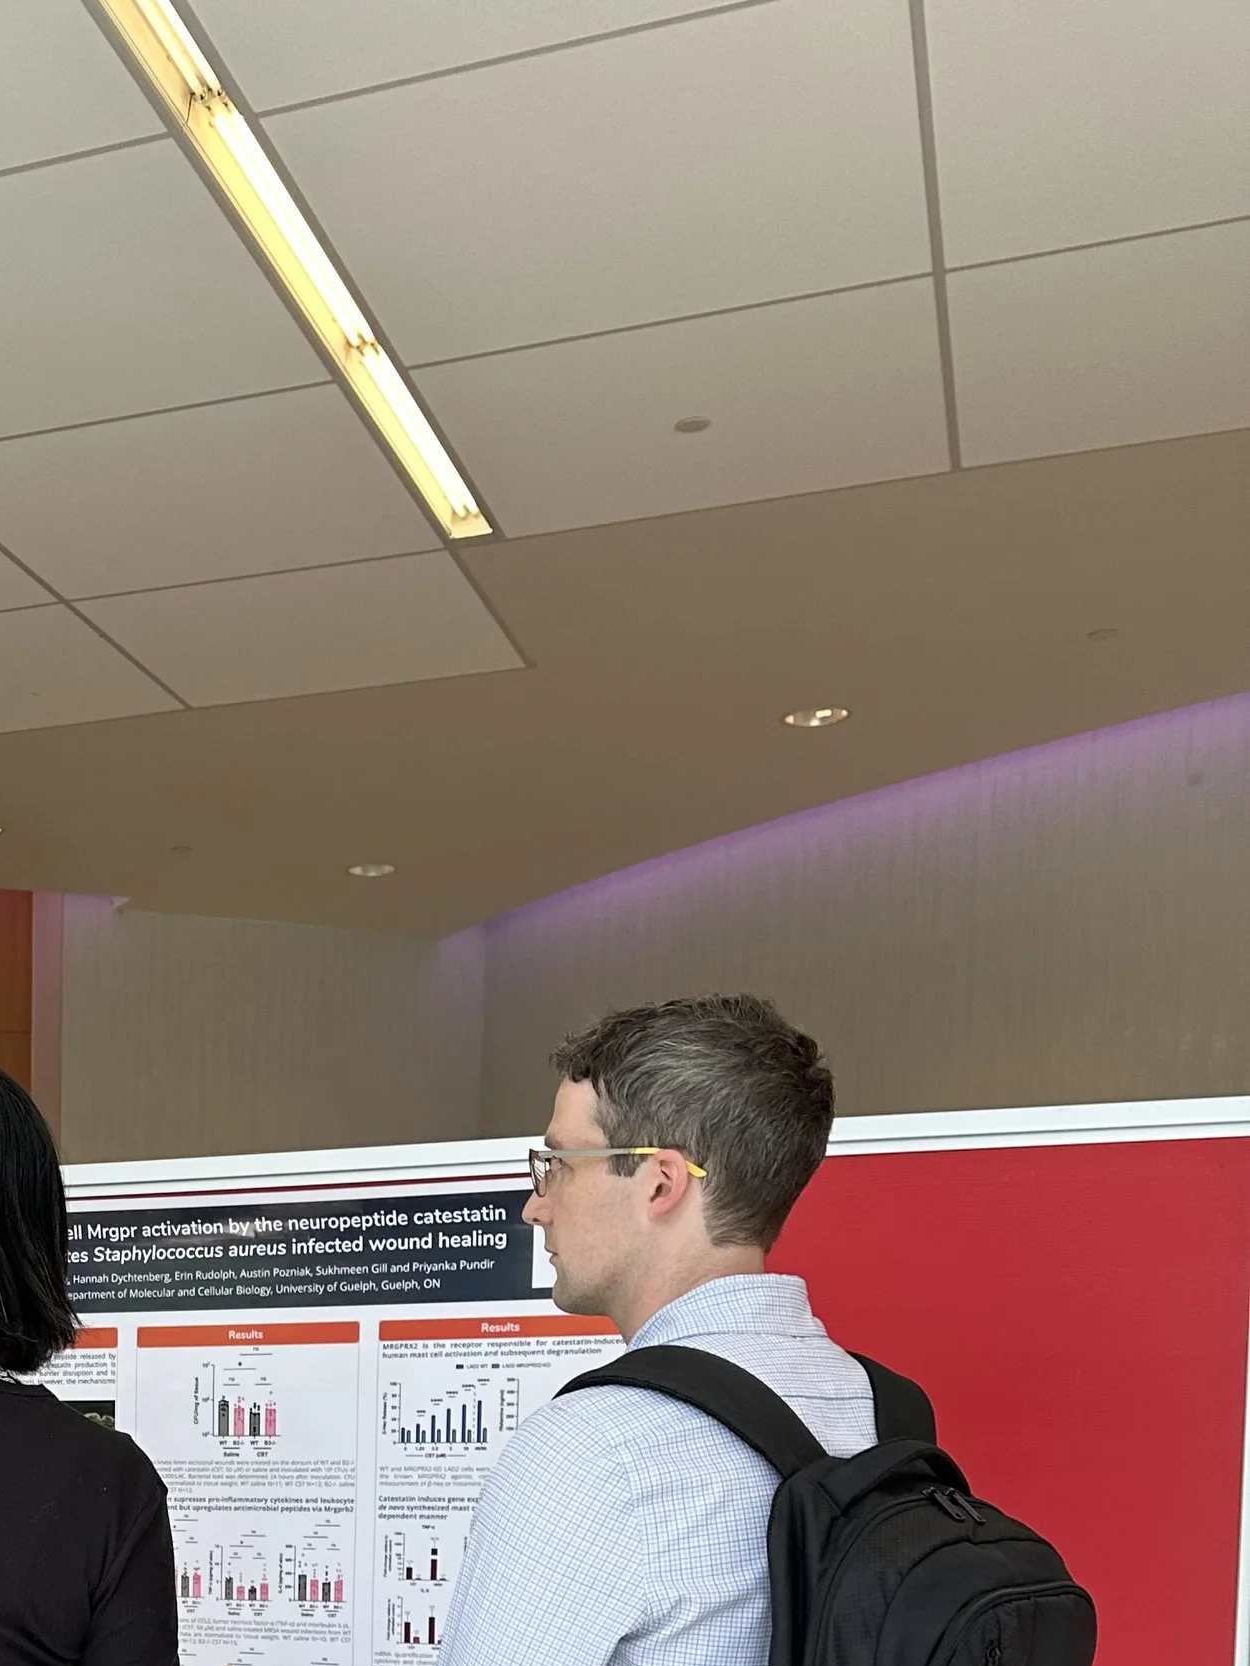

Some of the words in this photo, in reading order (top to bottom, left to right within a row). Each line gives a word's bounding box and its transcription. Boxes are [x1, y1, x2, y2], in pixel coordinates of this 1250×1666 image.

[67, 1224, 82, 1240] ell
[87, 1224, 138, 1243] Mrgpr
[141, 1219, 224, 1237] activation
[228, 1217, 250, 1238] by
[255, 1216, 283, 1233] the
[288, 1210, 409, 1232] neuropeptide
[413, 1204, 507, 1225] catestatin
[93, 1245, 224, 1264] Staphylococcus
[228, 1241, 287, 1258] aureus
[291, 1236, 364, 1255] infected
[369, 1232, 433, 1251] wound
[438, 1229, 508, 1250] healing
[73, 1274, 109, 1285] Hannah
[111, 1271, 172, 1286] Dychtenberg,
[174, 1270, 194, 1281] Erin
[195, 1268, 238, 1281] Rudolph,
[239, 1268, 271, 1279] Austin
[315, 1264, 369, 1276] Sukhmeen
[371, 1263, 388, 1273] Gill
[390, 1262, 410, 1273] and
[412, 1260, 457, 1273] Priyanka
[459, 1258, 496, 1270] Pundir
[68, 1289, 115, 1301] epartment
[117, 1288, 129, 1299] of
[129, 1287, 175, 1299] Molecular
[177, 1286, 196, 1297] and
[197, 1285, 234, 1296] Cellular
[236, 1284, 274, 1297] Biology,
[275, 1281, 325, 1296] University
[327, 1280, 338, 1292] of
[339, 1280, 378, 1293] Guelph,
[381, 1279, 421, 1292] Guelph,
[423, 1278, 441, 1289] ON
[481, 1322, 521, 1333] Results
[228, 1330, 264, 1341] Results
[422, 1342, 429, 1350] is
[433, 1342, 446, 1350] the
[450, 1342, 483, 1350] receptor
[487, 1340, 532, 1349] responsible
[536, 1339, 548, 1347] for
[430, 1350, 443, 1358] cell
[444, 1350, 483, 1358] activation
[500, 1348, 545, 1357] subsequent
[546, 1347, 602, 1357] degranulation
[305, 1496, 319, 1504] and
[417, 1495, 446, 1503] induces
[447, 1496, 466, 1504] gene
[178, 1503, 191, 1511] but
[192, 1504, 232, 1512] upregulates
[280, 1505, 311, 1513] peptides
[406, 1504, 450, 1512] synthesized
[378, 1513, 417, 1521] dependent
